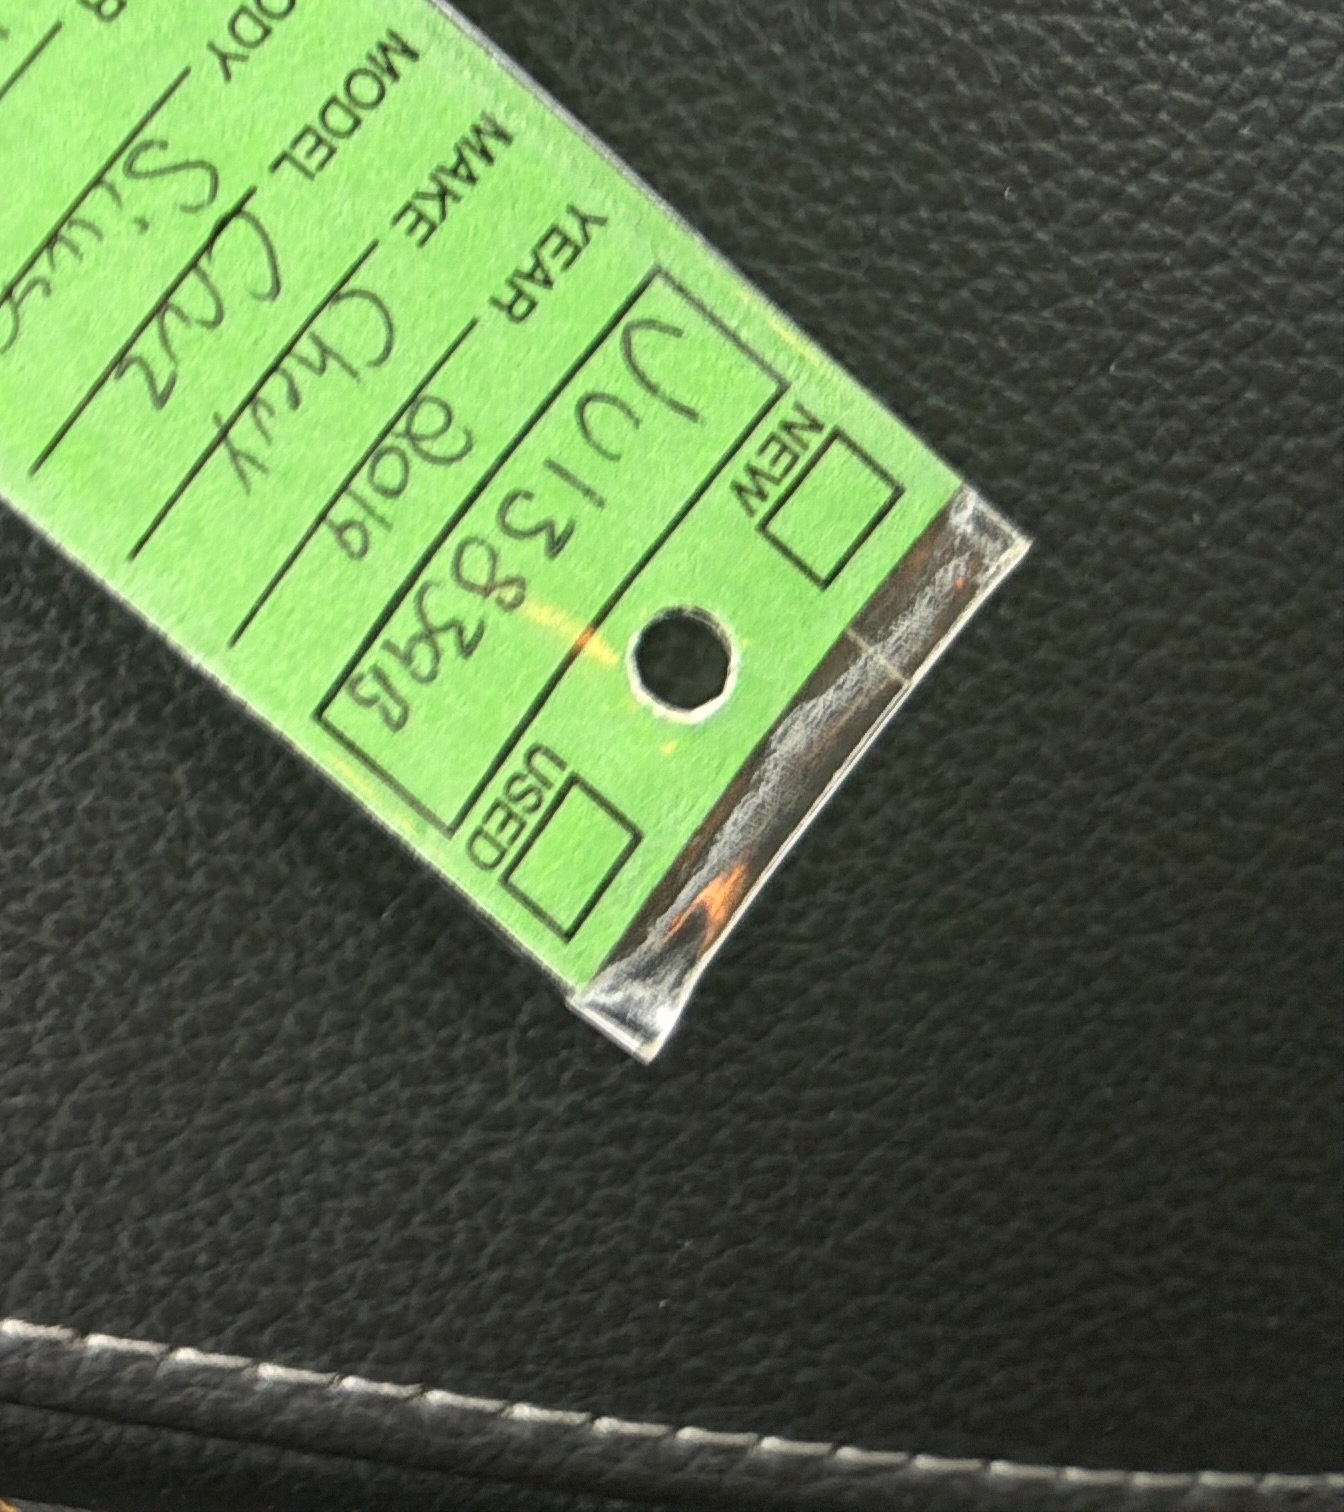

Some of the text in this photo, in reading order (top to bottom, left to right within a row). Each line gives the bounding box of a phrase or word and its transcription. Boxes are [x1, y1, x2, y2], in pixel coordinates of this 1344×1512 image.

[267, 27, 422, 182] MODEL
[210, 110, 516, 495] MAKE Chevy
[326, 203, 610, 562] YEAR 2019
[730, 400, 827, 519] NEW
[465, 741, 570, 873] USED
